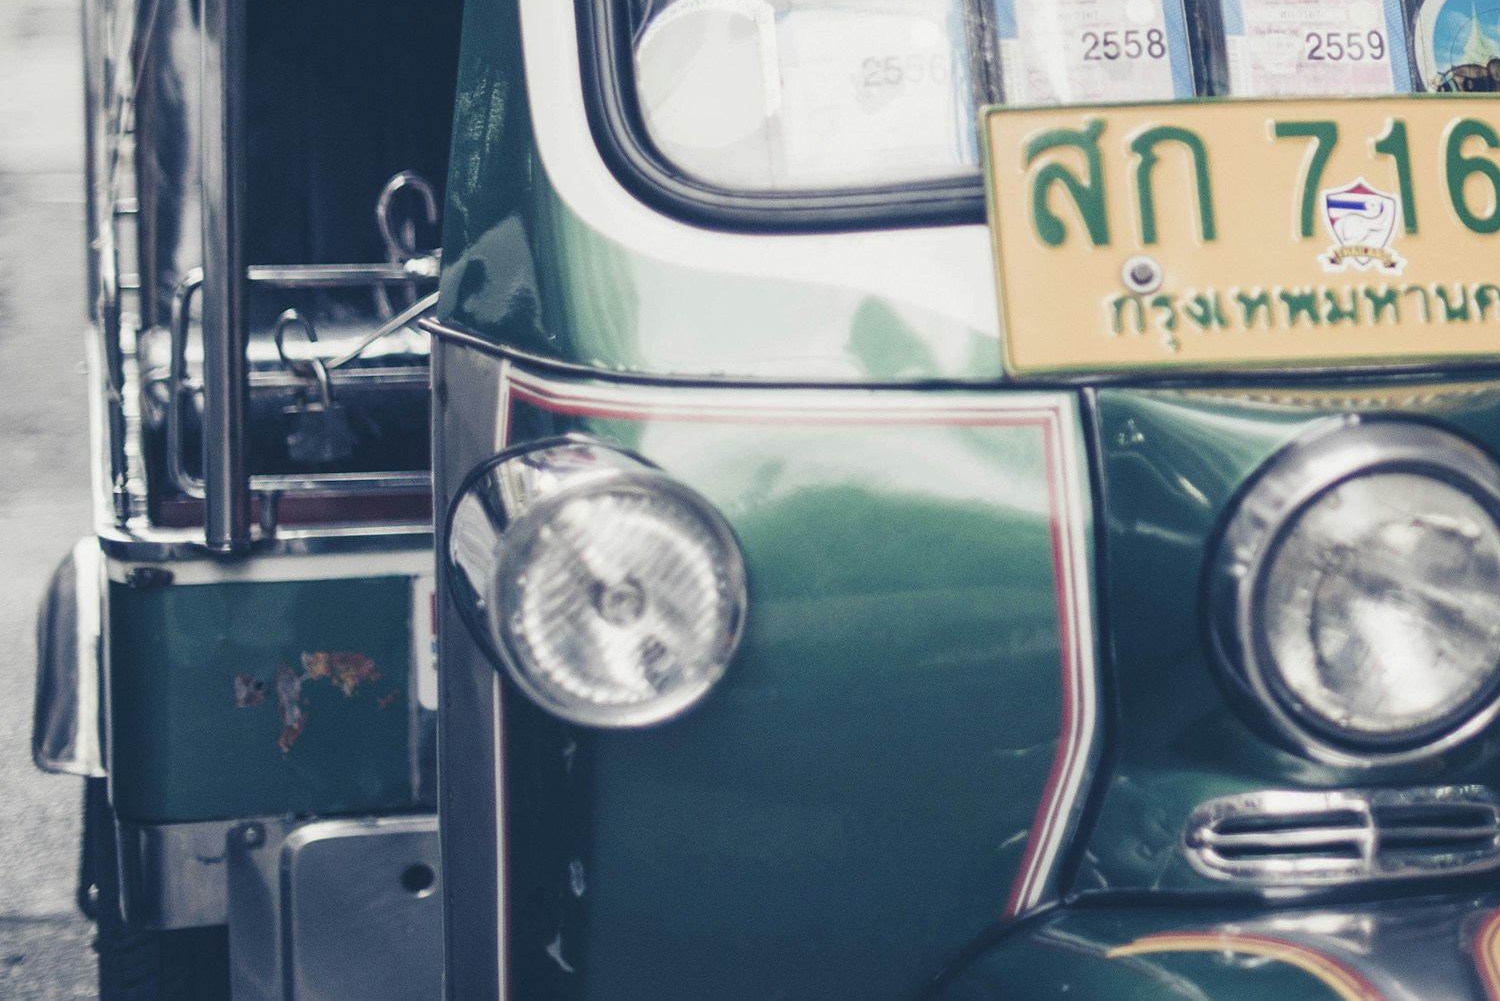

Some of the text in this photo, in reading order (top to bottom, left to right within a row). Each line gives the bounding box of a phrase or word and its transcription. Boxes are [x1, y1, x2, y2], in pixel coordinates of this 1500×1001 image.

[1081, 28, 1167, 61] 2558
[1305, 29, 1386, 62] 2559
[1022, 115, 1217, 248] สก
